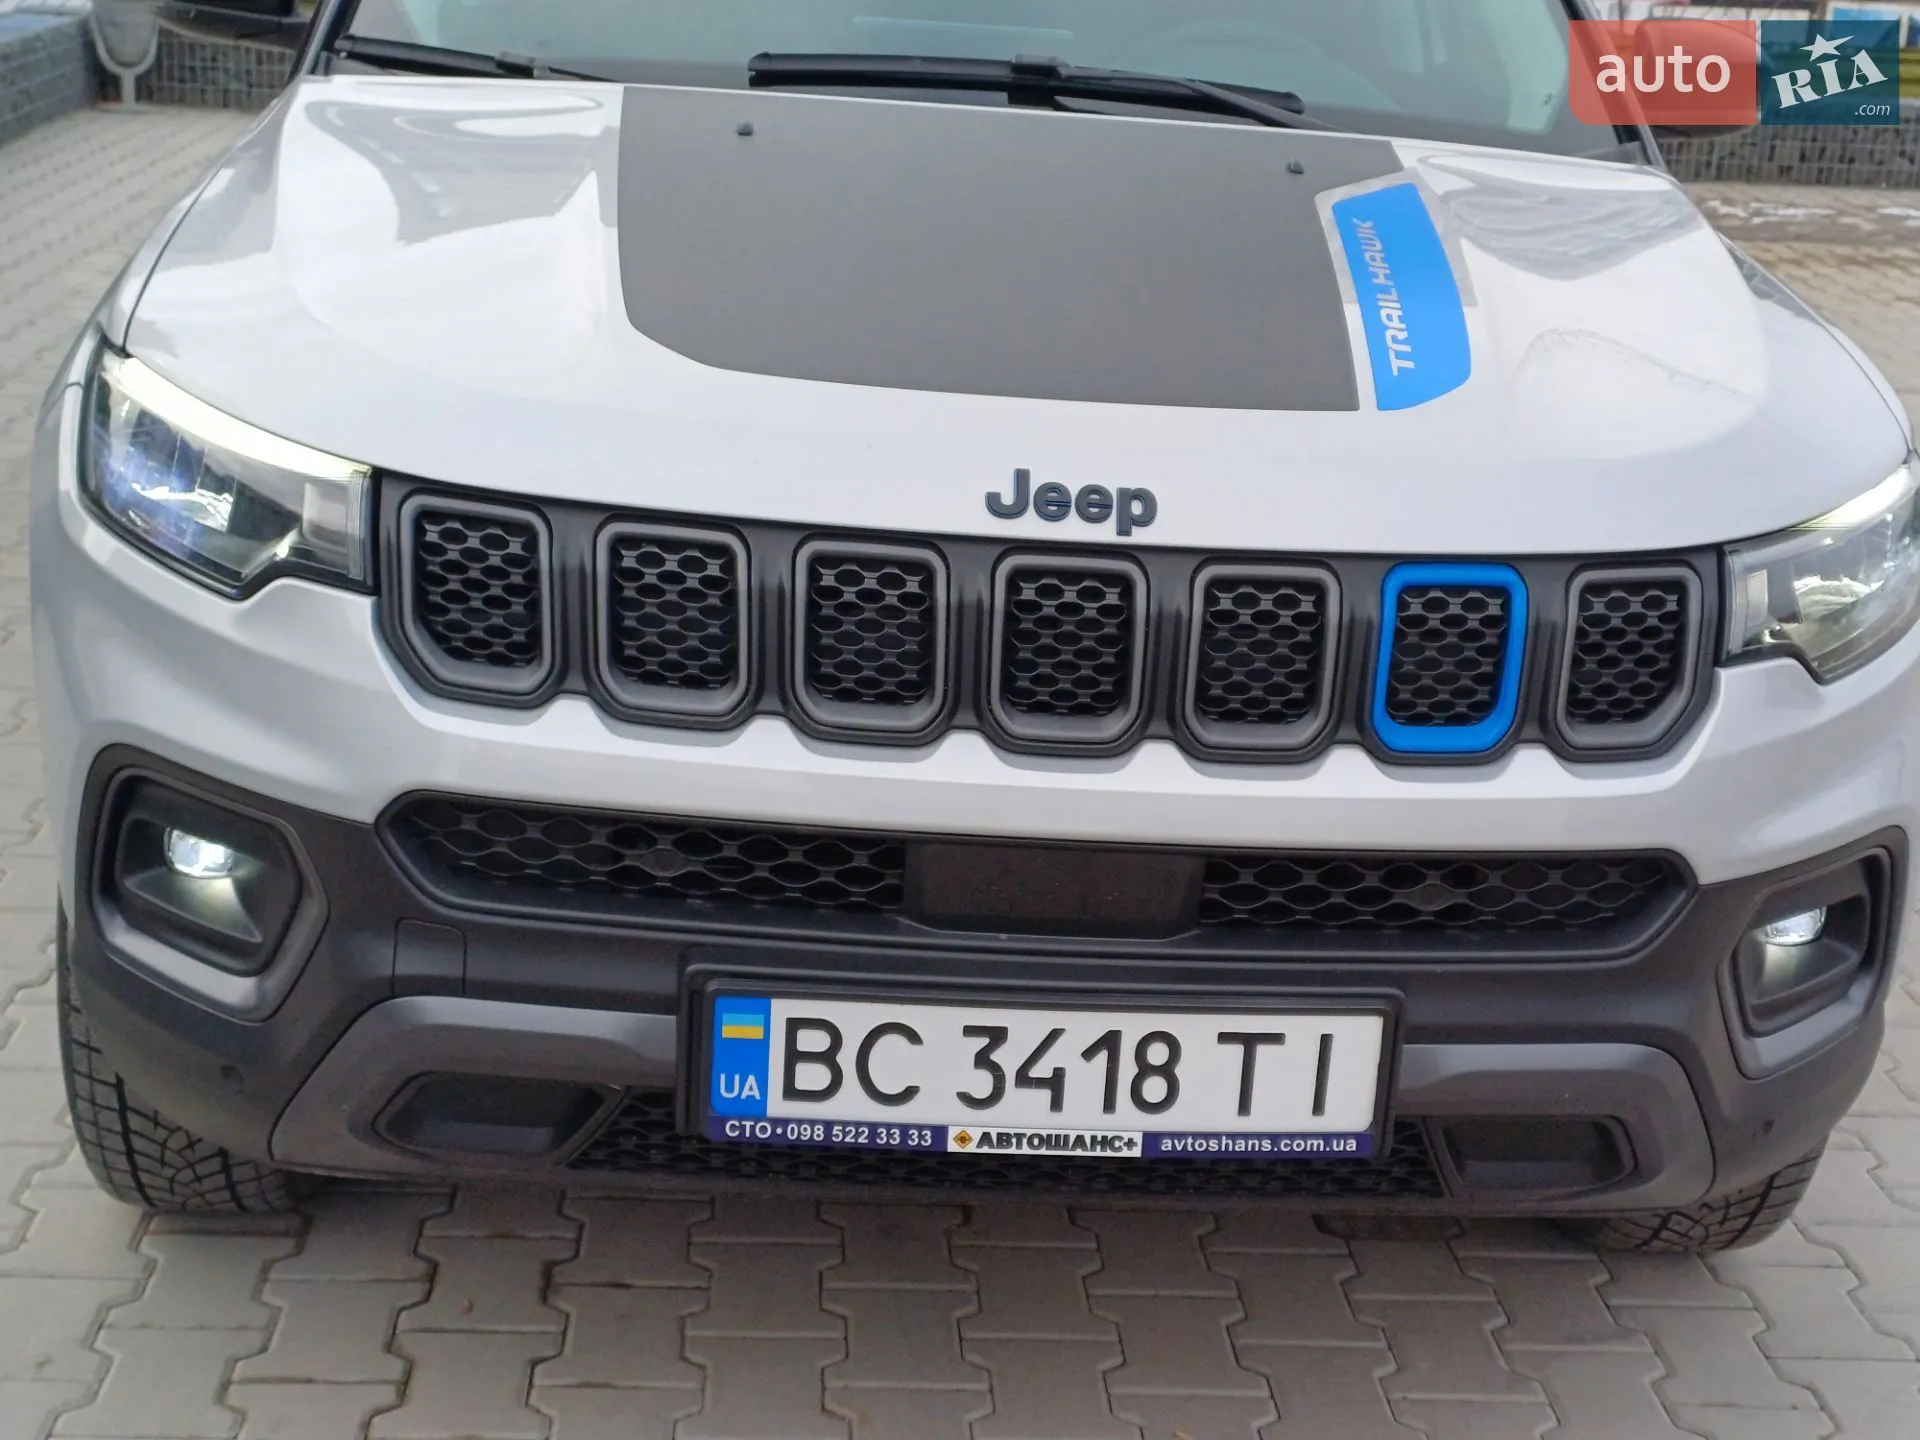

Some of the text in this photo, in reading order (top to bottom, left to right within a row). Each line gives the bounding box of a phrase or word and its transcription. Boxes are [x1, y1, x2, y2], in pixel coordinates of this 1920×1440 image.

[984, 467, 1158, 537] Jeep
[782, 1016, 924, 1108] BC
[955, 1024, 1182, 1115] 3418
[719, 1072, 762, 1101] UA
[831, 1126, 869, 1144] 522
[875, 1128, 901, 1146] 33
[907, 1129, 933, 1147] 33
[975, 1131, 1139, 1154] АВТОШАНС+
[1160, 1136, 1358, 1153] avtoshans.com.ua
